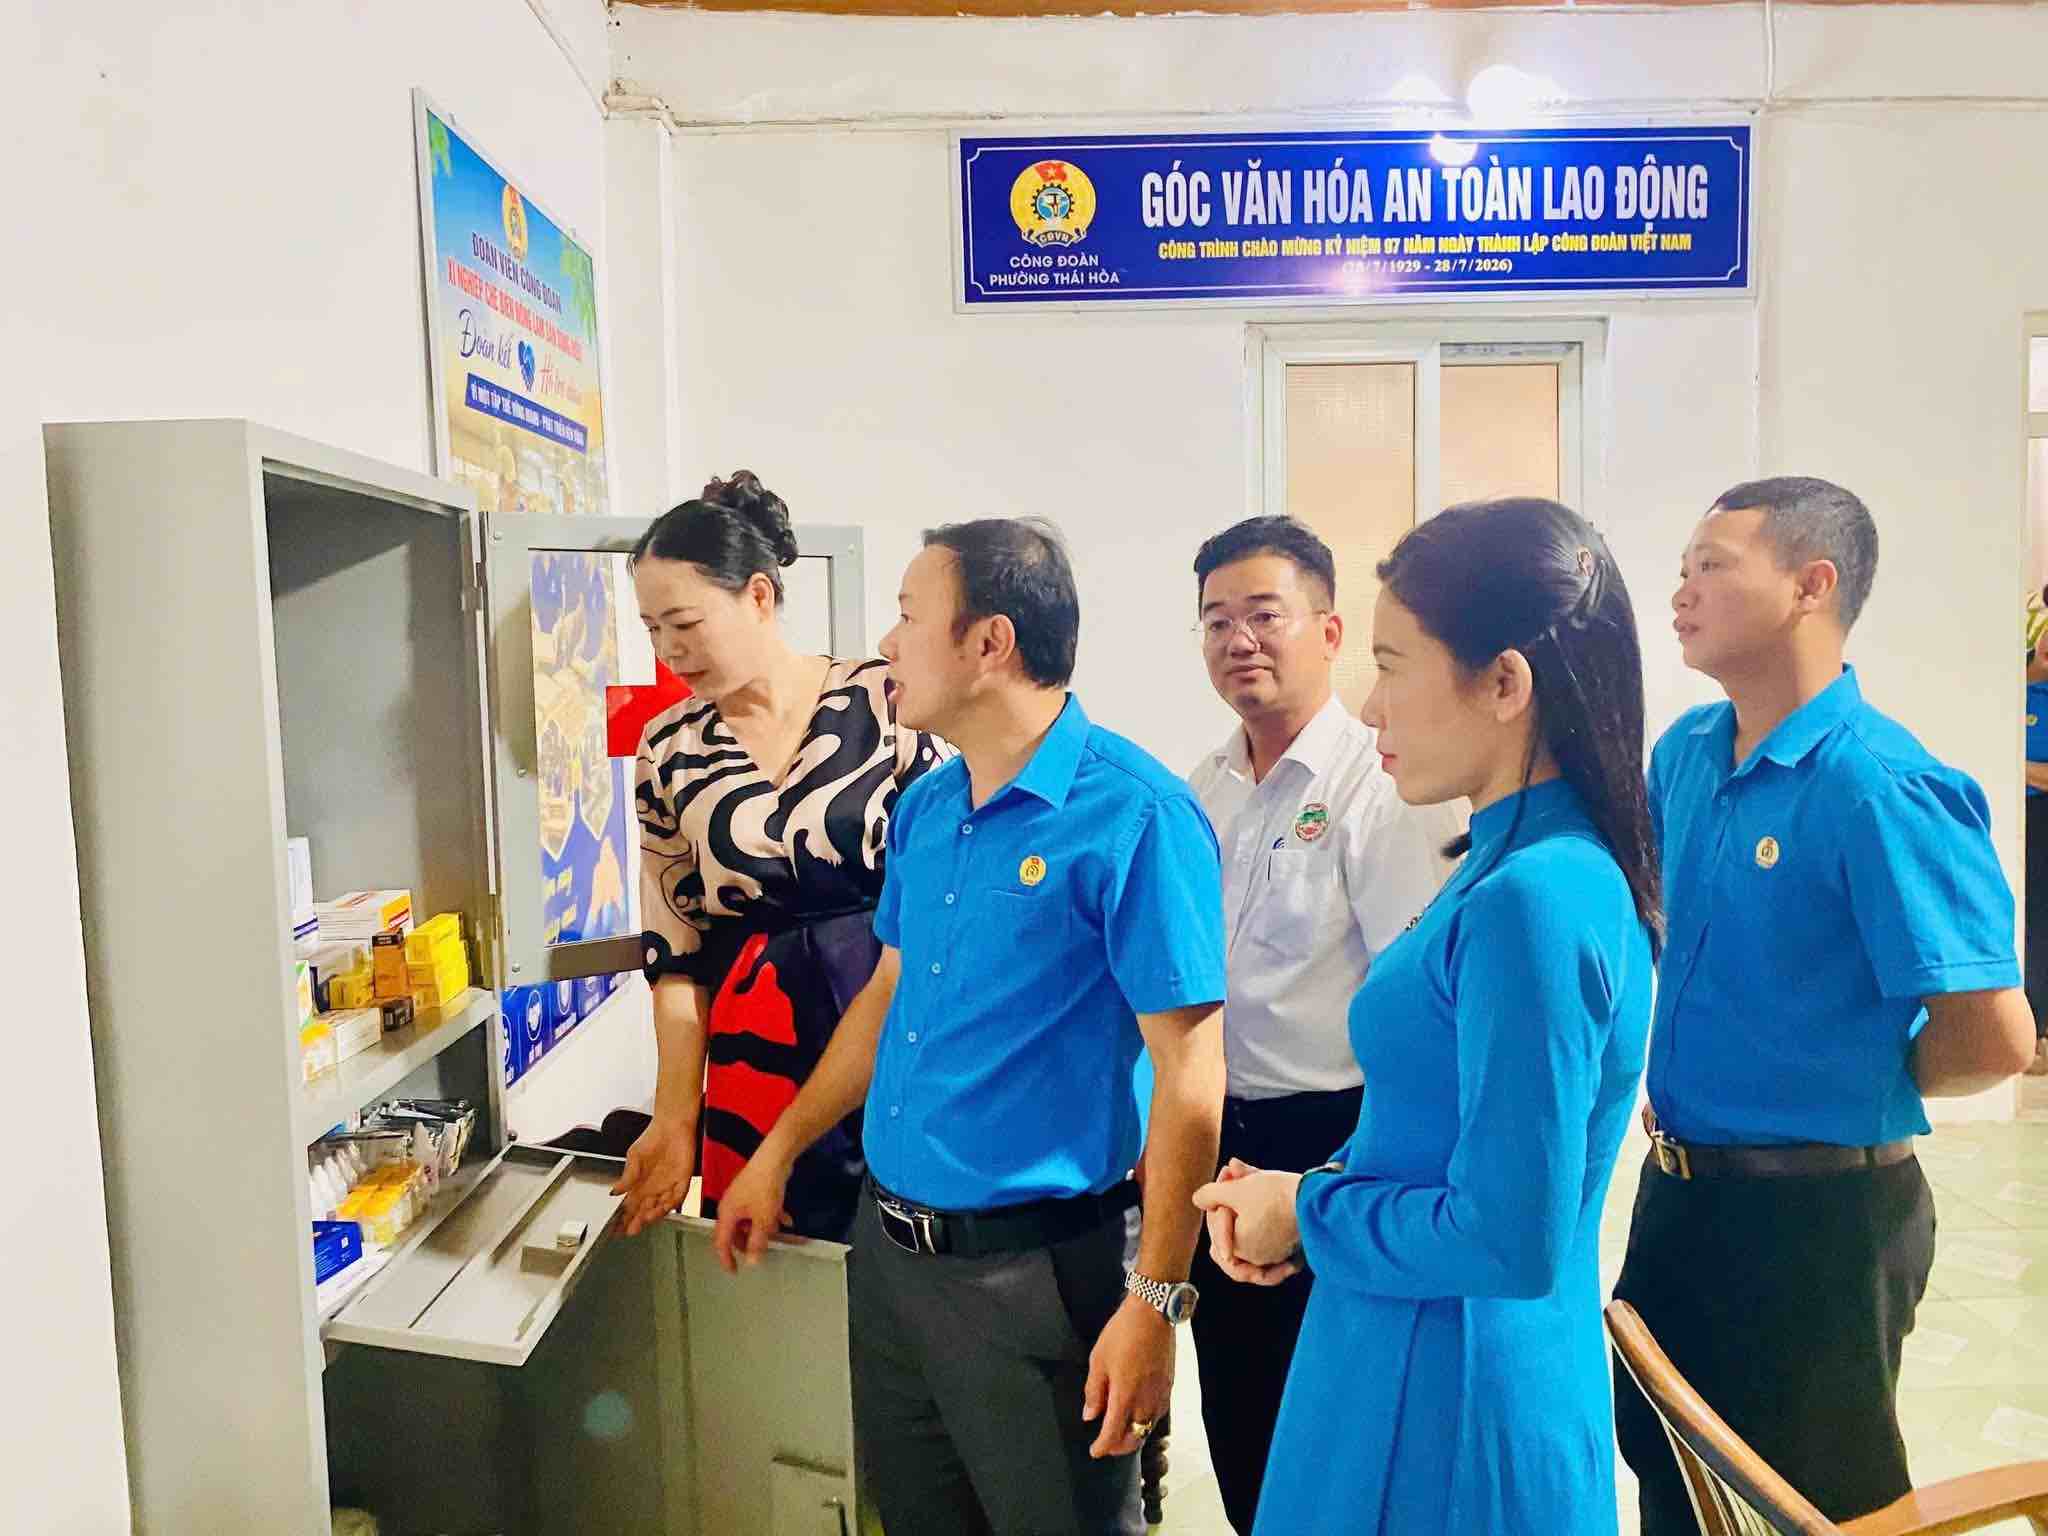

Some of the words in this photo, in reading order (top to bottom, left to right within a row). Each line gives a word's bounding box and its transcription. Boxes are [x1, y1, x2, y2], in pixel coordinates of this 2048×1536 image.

[1141, 159, 1212, 228] GÓC
[1221, 158, 1292, 226] VĂN
[1302, 156, 1374, 225] HÓA
[1383, 168, 1432, 223] AN
[1441, 155, 1532, 222] TOÀN
[1543, 165, 1605, 221] LAO
[1614, 154, 1709, 234] ĐỘNG
[1158, 239, 1196, 259] CÔNG
[1199, 238, 1239, 258] TRÌNH
[1242, 237, 1279, 257] CHÀO
[1281, 236, 1322, 257] MỪNG
[1345, 235, 1381, 258] NIỆM
[1403, 234, 1436, 255] NĂM
[1438, 233, 1474, 254] NGÀY
[1477, 232, 1521, 253] THÀNH
[1523, 232, 1549, 255] LẬP
[1551, 232, 1588, 252] CÔNG
[1591, 232, 1628, 252] ĐOÀN
[1630, 232, 1658, 255] VIỆT
[1660, 234, 1692, 251] NAM
[1009, 253, 1054, 269] CÔNG
[1056, 251, 1099, 268] ĐOÀN
[988, 270, 1050, 287] PHƯỜNG
[1052, 269, 1084, 286] THÁI
[1088, 268, 1121, 285] HÒA
